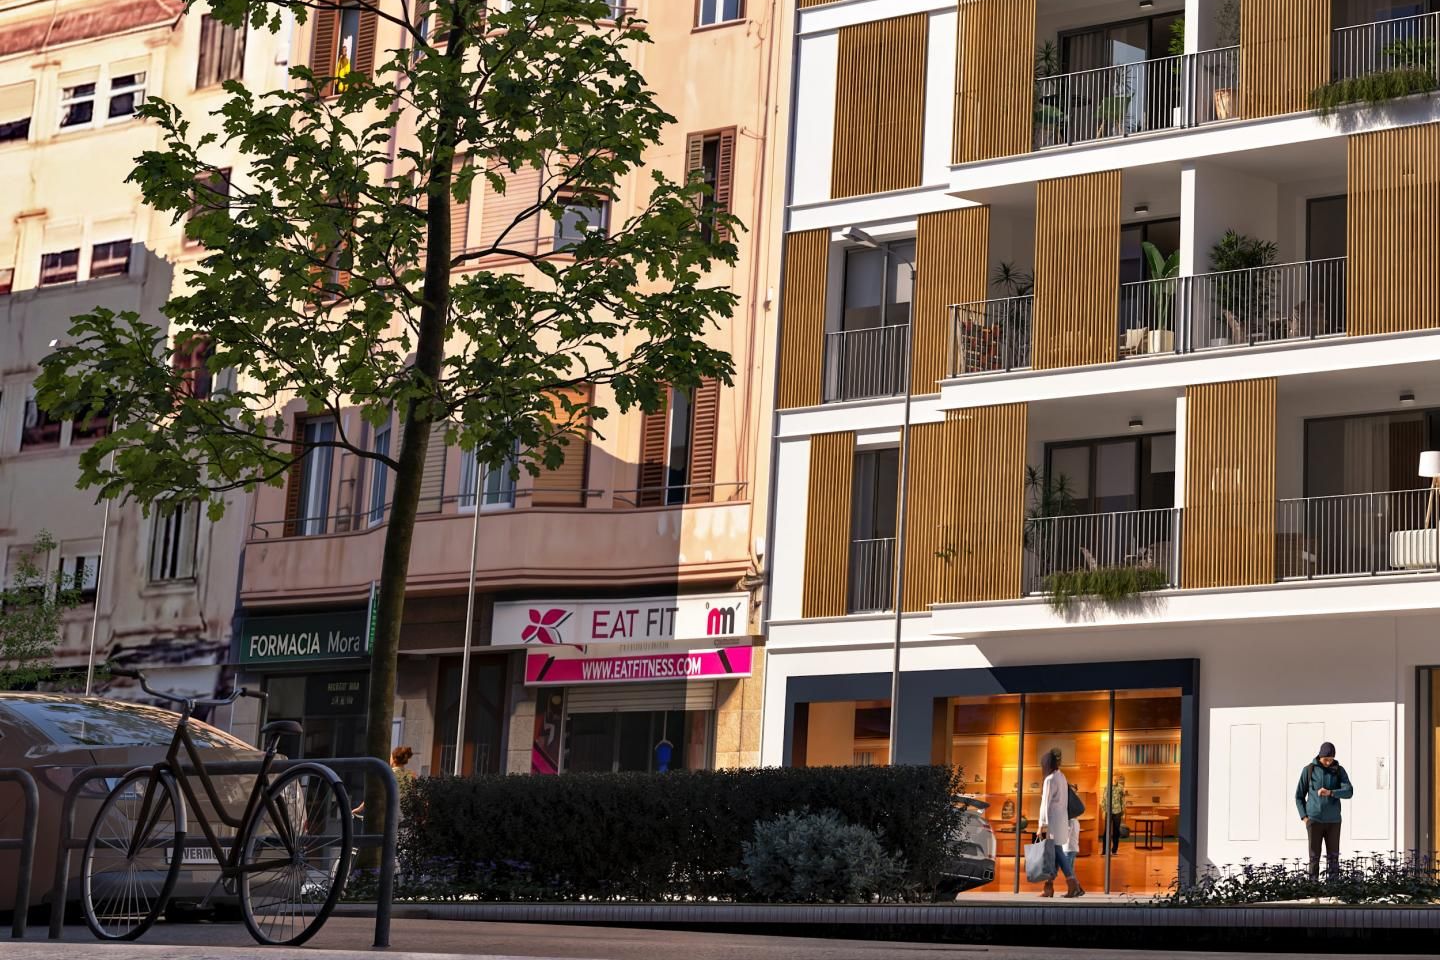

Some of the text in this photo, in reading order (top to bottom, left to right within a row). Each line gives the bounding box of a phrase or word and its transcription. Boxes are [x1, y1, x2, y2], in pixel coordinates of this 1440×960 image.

[591, 607, 679, 639] EAT FIT
[249, 630, 360, 657] FORMACIA Mora
[582, 656, 702, 680] WWW.EATFITNESS.COM
